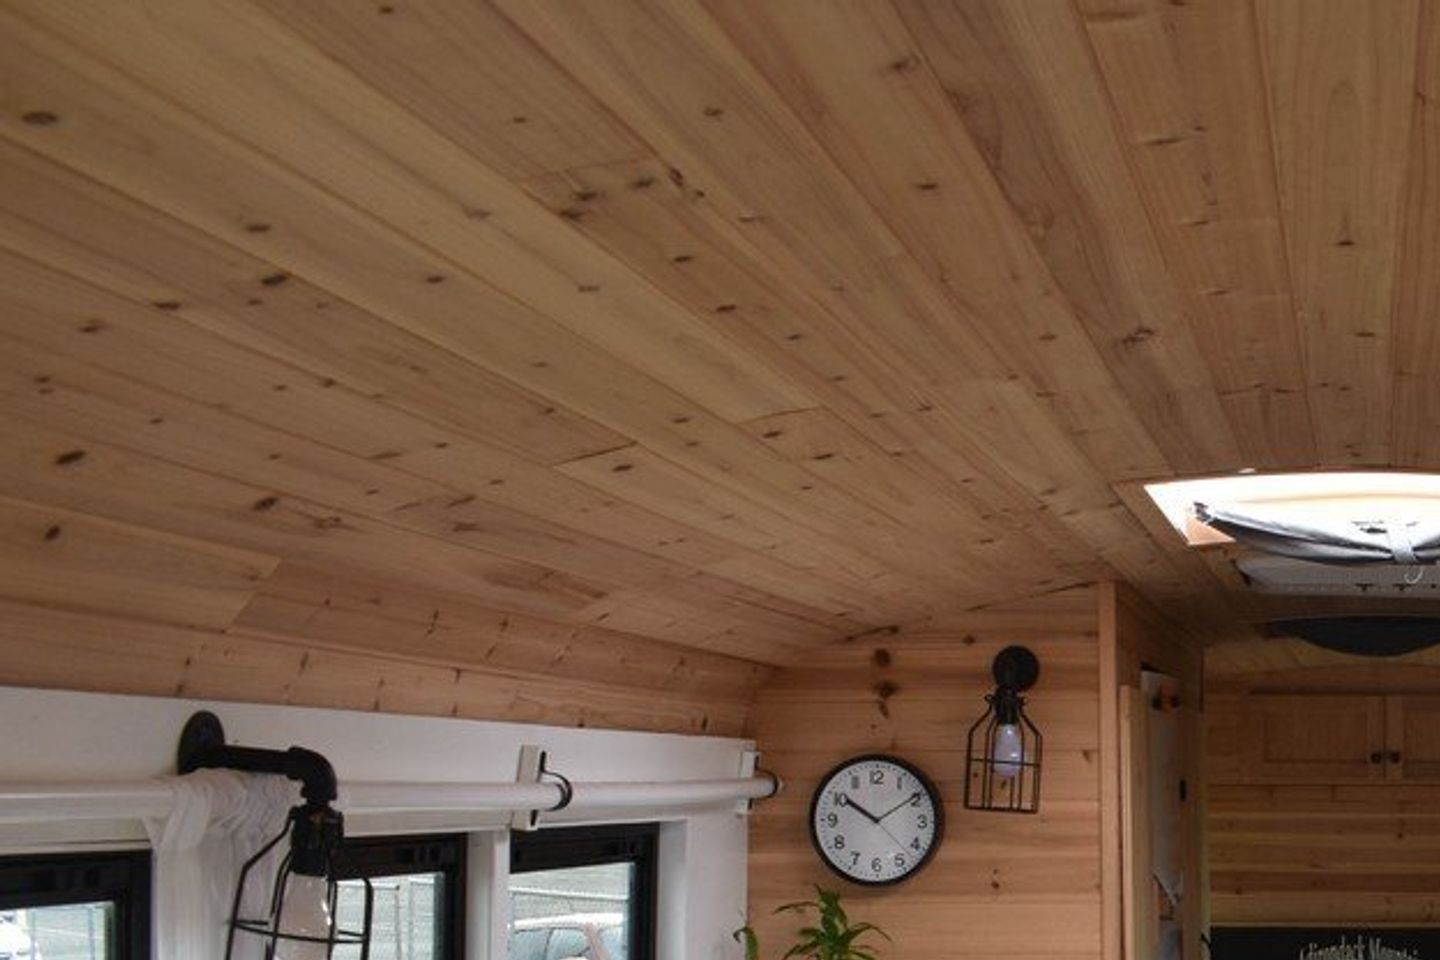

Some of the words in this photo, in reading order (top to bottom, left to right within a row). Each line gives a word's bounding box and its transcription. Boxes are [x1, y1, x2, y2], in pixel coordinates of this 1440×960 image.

[869, 770, 885, 785] 12
[834, 792, 849, 808] 10
[910, 792, 922, 807] 2
[827, 813, 838, 828] 9
[916, 814, 928, 829] 3
[833, 834, 846, 850] 8
[910, 837, 921, 851] 4
[851, 852, 861, 866] 7
[871, 858, 883, 873] 6
[894, 852, 905, 867] 5
